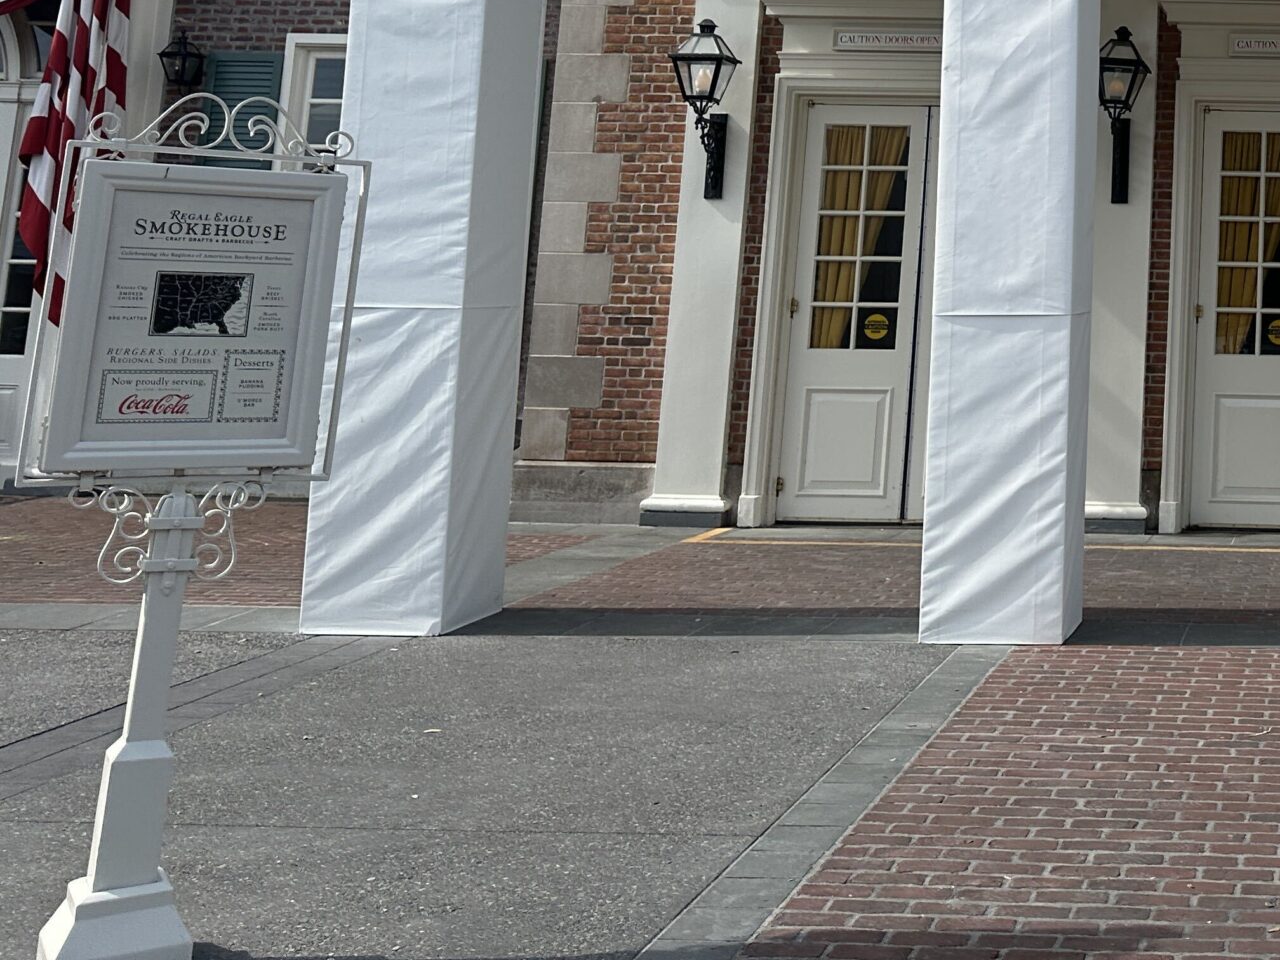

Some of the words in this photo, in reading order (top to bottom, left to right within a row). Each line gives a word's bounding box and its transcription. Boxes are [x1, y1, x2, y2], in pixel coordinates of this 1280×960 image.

[884, 35, 915, 45] DOORS
[916, 36, 941, 45] OPEN
[170, 210, 210, 223] REGAL
[214, 212, 253, 223] EAGLE
[134, 218, 287, 241] SMOKEHOUSE
[234, 358, 274, 367] Desserts
[111, 377, 133, 385] Now
[135, 377, 169, 387] proudly
